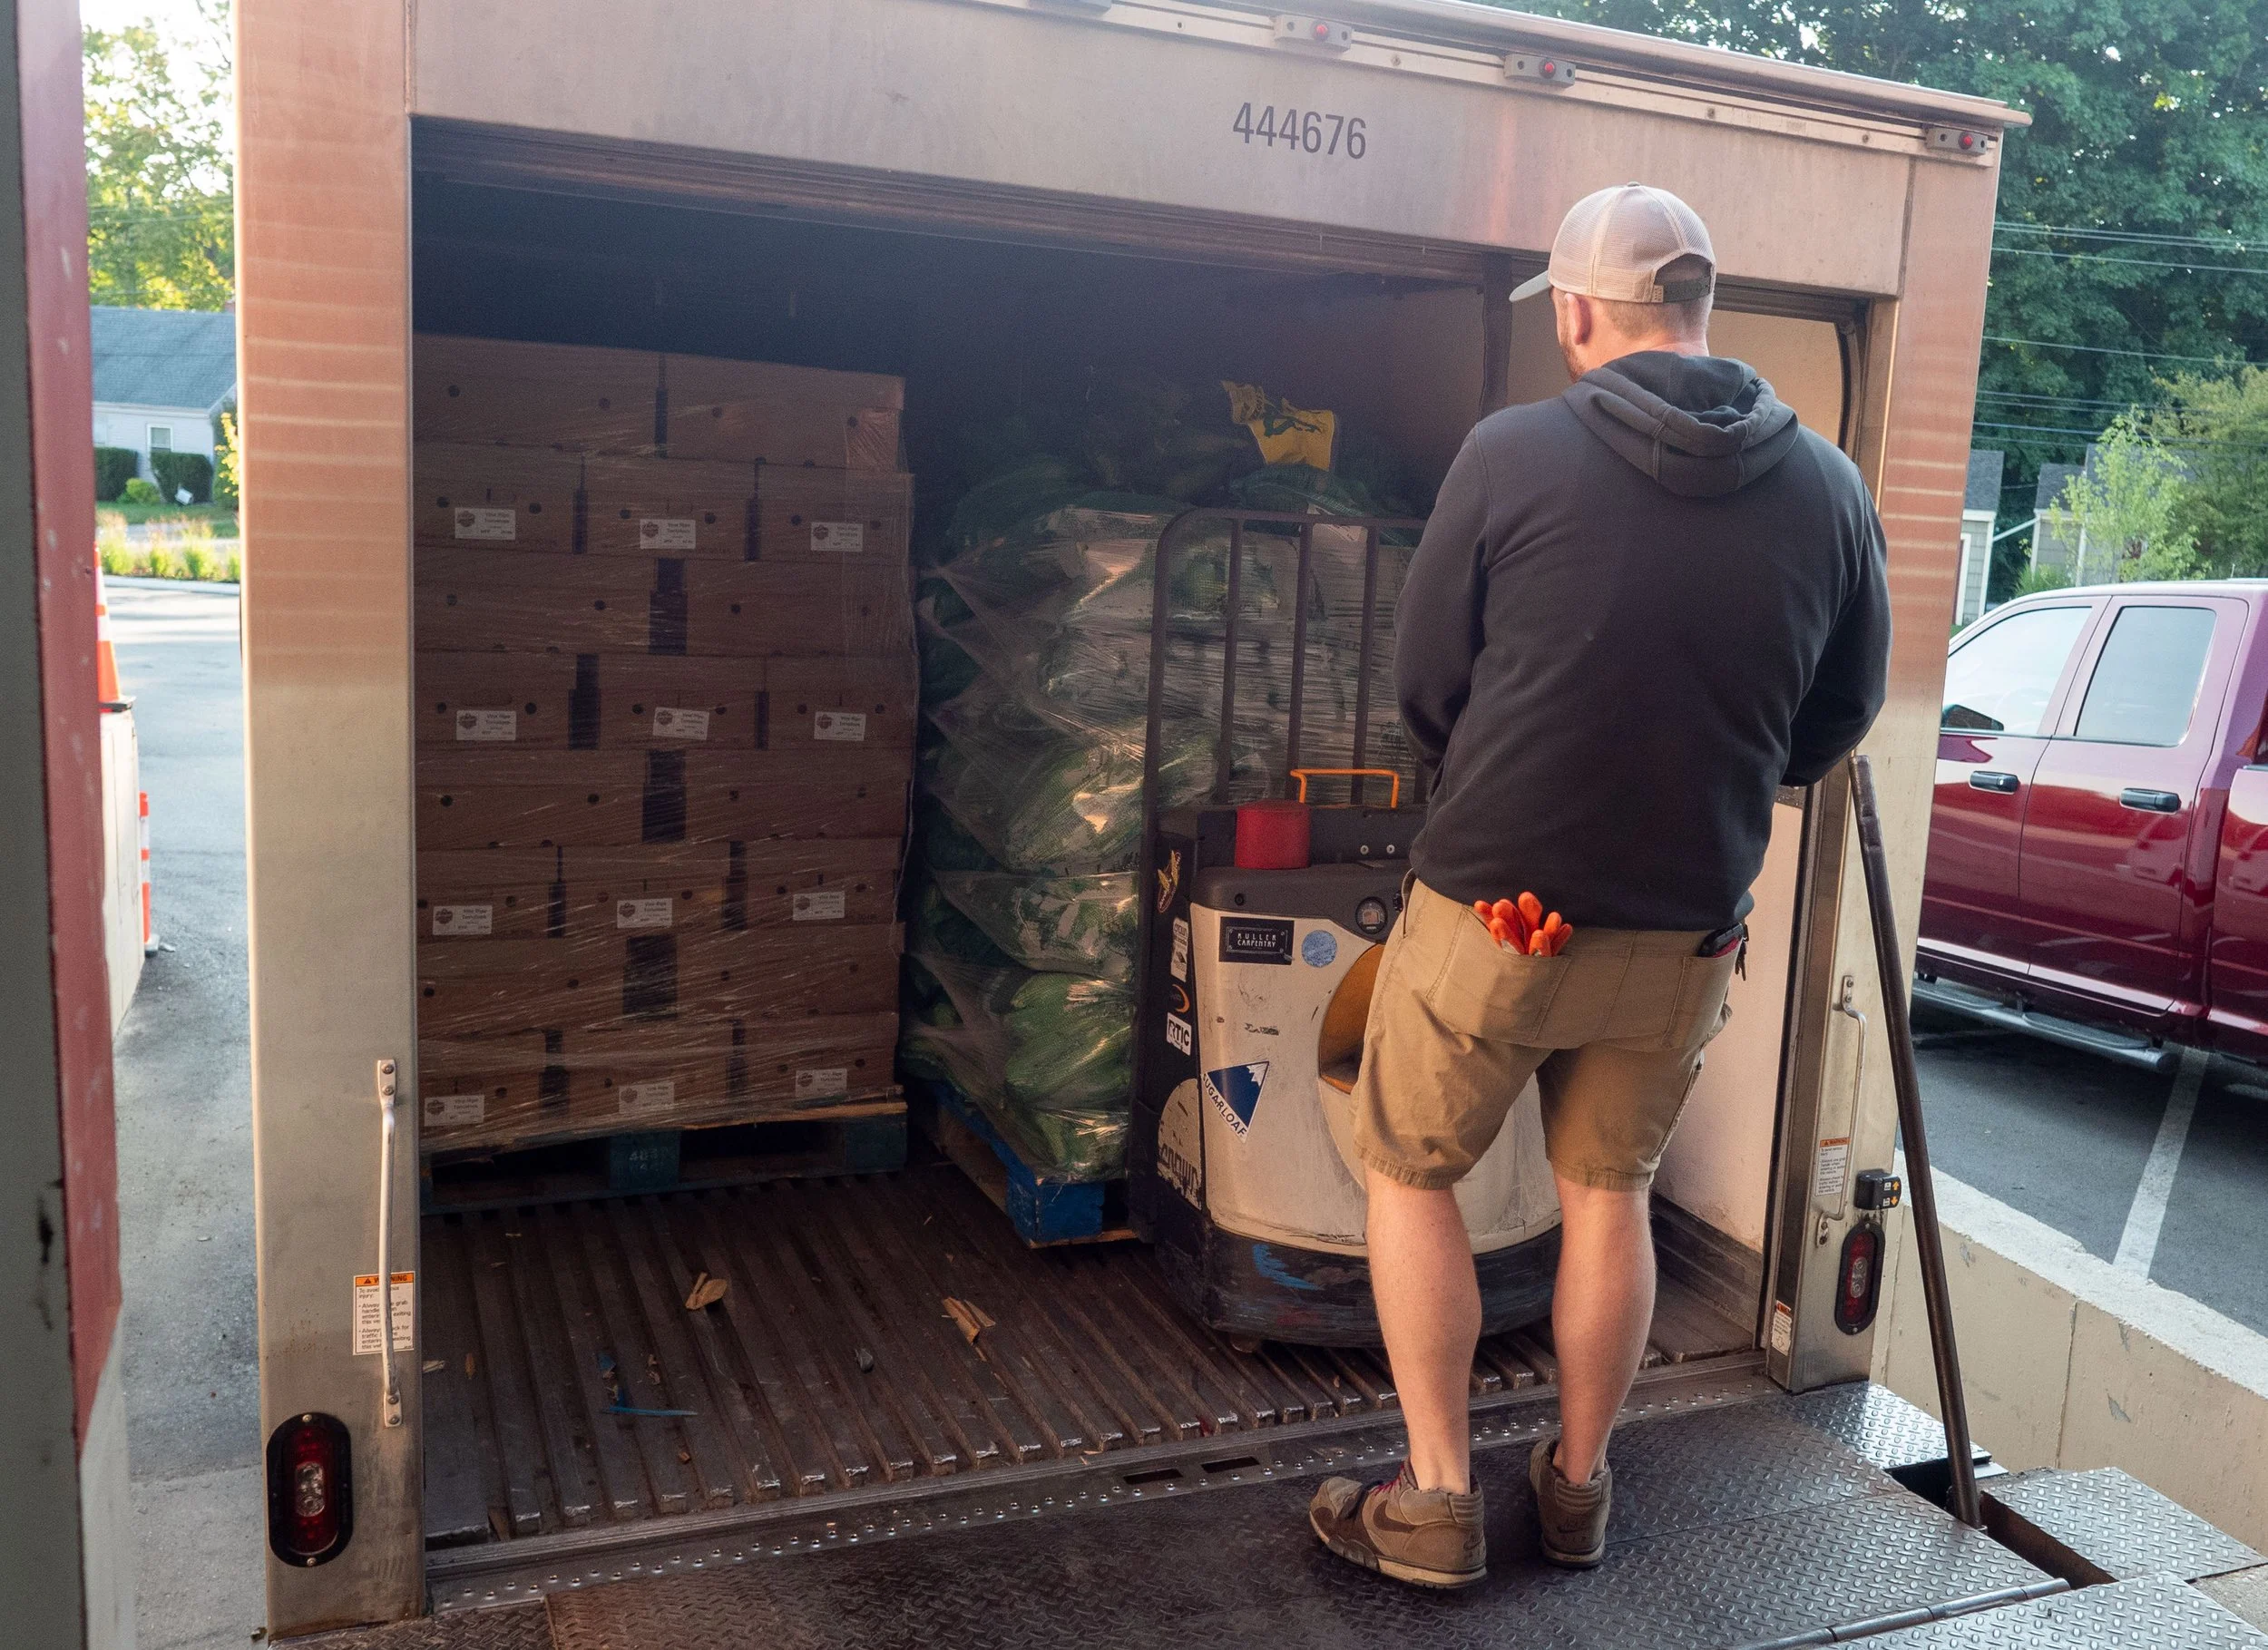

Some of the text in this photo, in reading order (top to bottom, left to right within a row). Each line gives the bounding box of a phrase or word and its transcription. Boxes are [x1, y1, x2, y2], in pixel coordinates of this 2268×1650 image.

[1233, 103, 1366, 160] 444676
[1237, 939, 1276, 948] CARPENTRY
[1168, 1020, 1189, 1046] RTIC
[1202, 1073, 1247, 1137] SUGARLOAF
[374, 1274, 407, 1283] WNING
